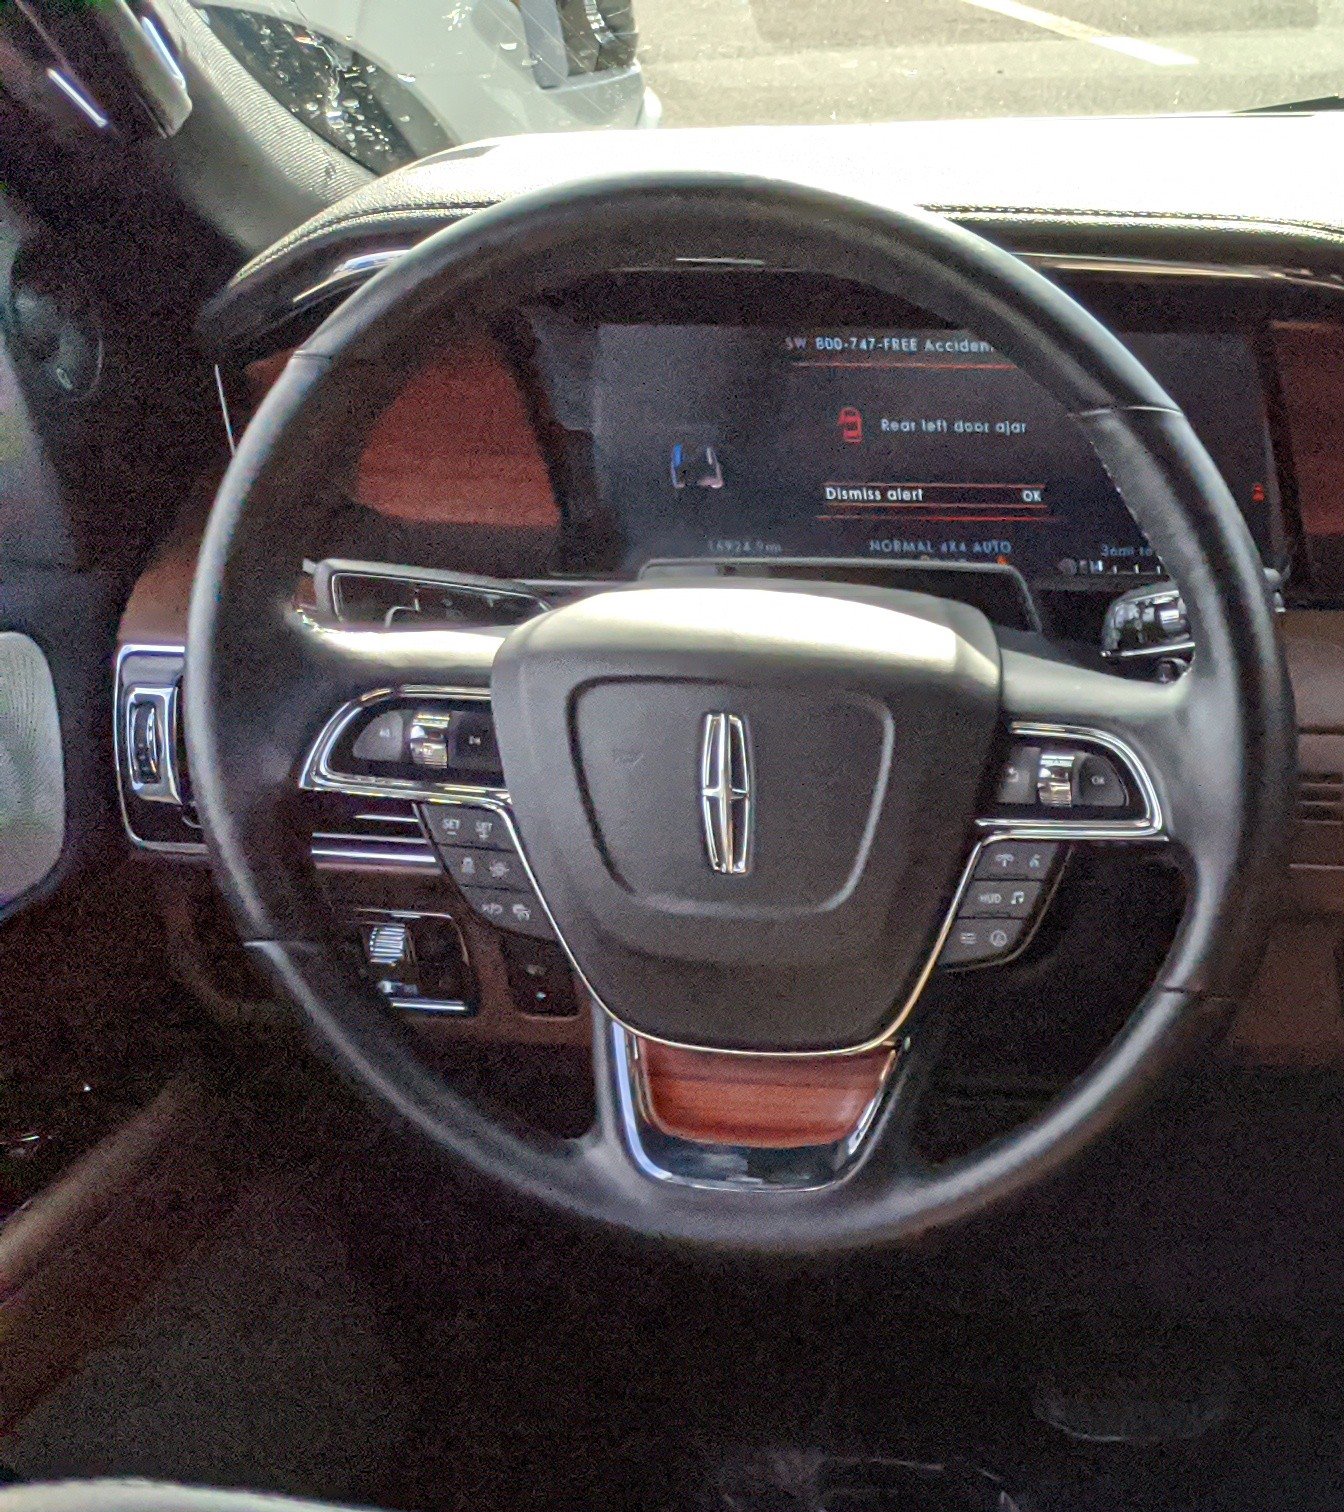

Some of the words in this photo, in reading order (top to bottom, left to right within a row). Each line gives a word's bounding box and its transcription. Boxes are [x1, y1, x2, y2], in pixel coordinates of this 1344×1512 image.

[880, 419, 916, 433] Rear
[922, 419, 947, 433] left
[953, 419, 989, 434] door
[825, 487, 882, 501] Dismiss
[886, 487, 924, 501] alert
[1021, 488, 1042, 503] OK
